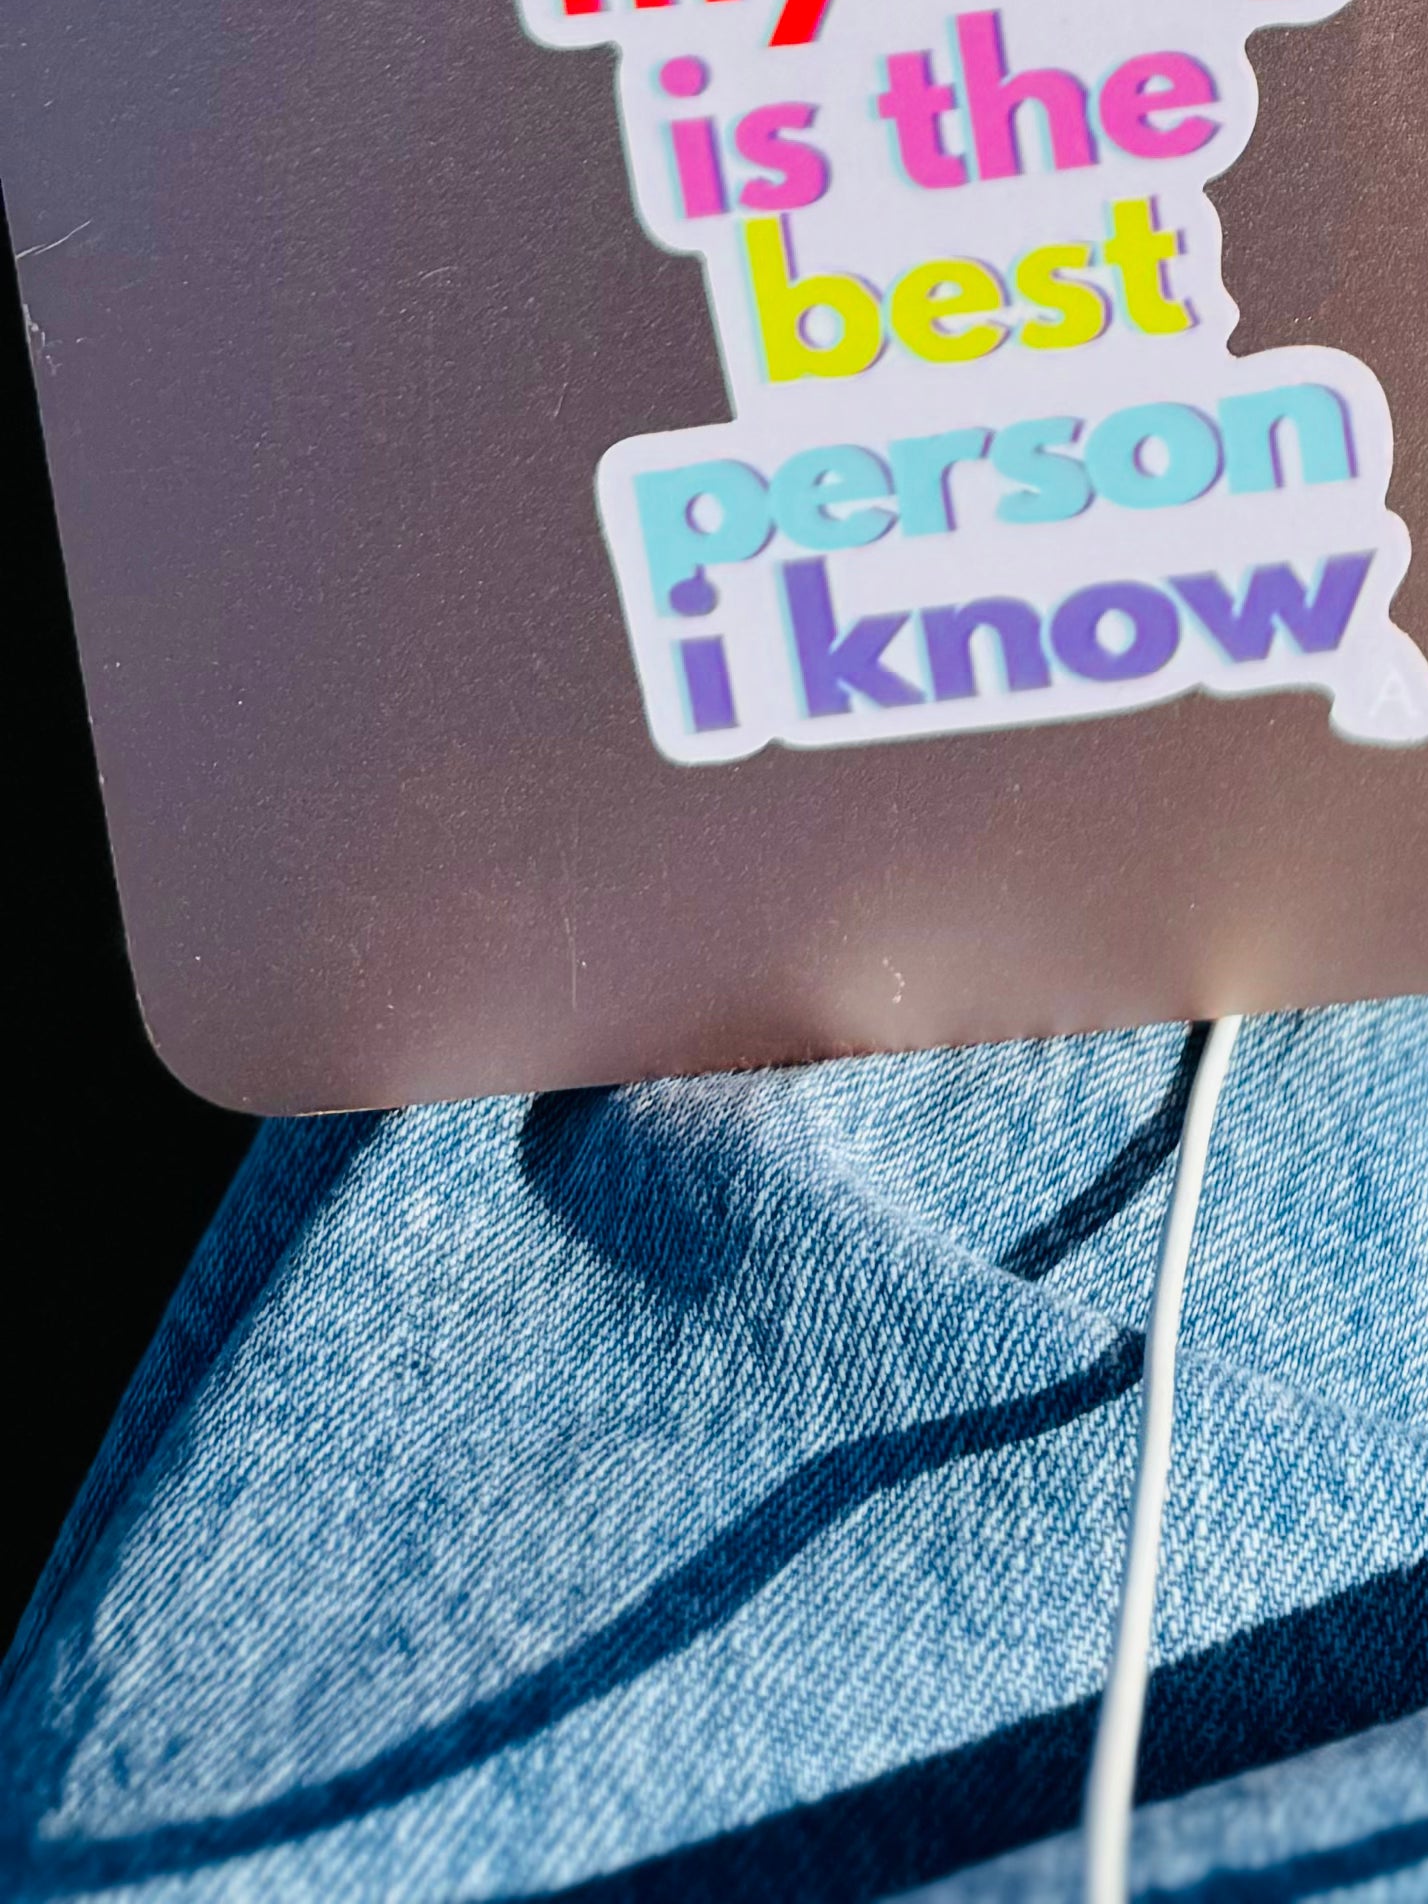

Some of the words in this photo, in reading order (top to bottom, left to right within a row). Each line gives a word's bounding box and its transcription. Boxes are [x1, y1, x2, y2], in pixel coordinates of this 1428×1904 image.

[653, 54, 833, 220] is
[876, 8, 1224, 191] the
[741, 194, 1200, 385] best
[632, 382, 1360, 619] person
[664, 566, 741, 735] i
[778, 550, 1378, 720] know
